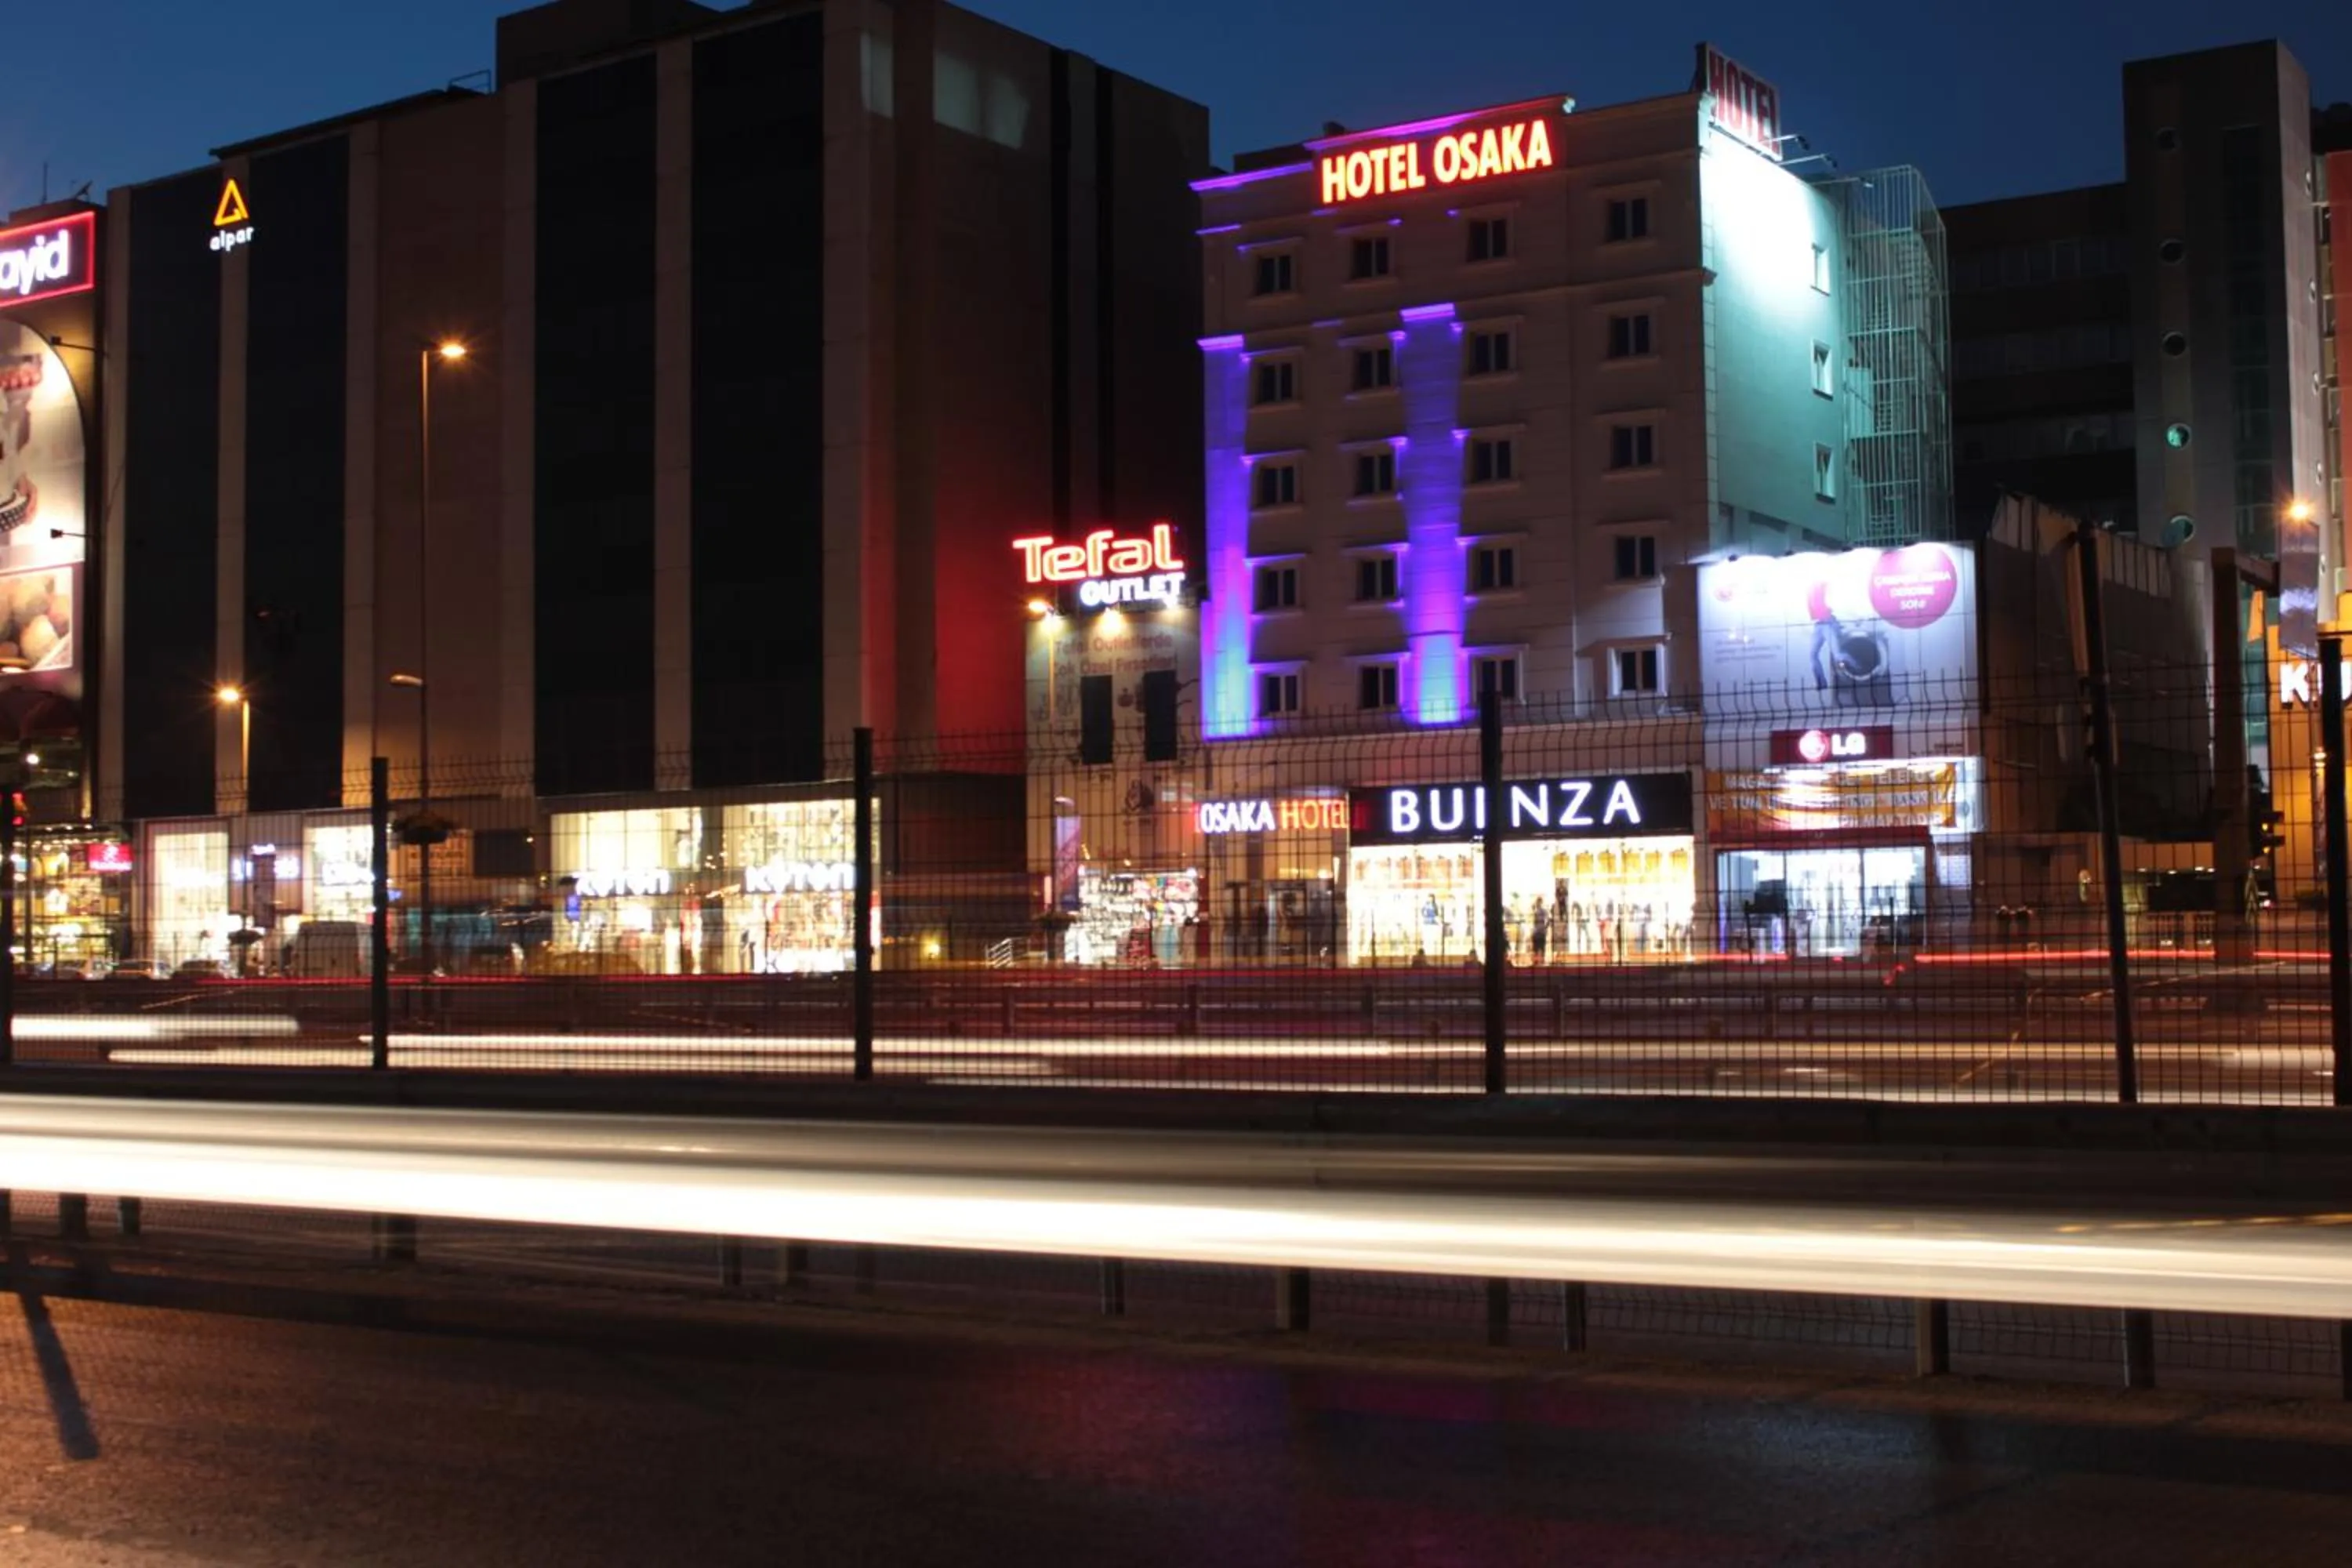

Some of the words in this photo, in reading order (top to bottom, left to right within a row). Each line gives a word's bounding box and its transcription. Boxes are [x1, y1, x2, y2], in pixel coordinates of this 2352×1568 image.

[1709, 49, 1780, 155] HOTEL
[1323, 142, 1425, 204] HOTEL
[1434, 119, 1552, 183] OSAKA
[209, 227, 254, 252] alpar
[1012, 524, 1184, 583] Tefal
[1080, 572, 1185, 606] OUTLET
[1831, 733, 1866, 756] LG
[1200, 800, 1276, 833] OSAKA
[1280, 799, 1348, 830] HOTEL
